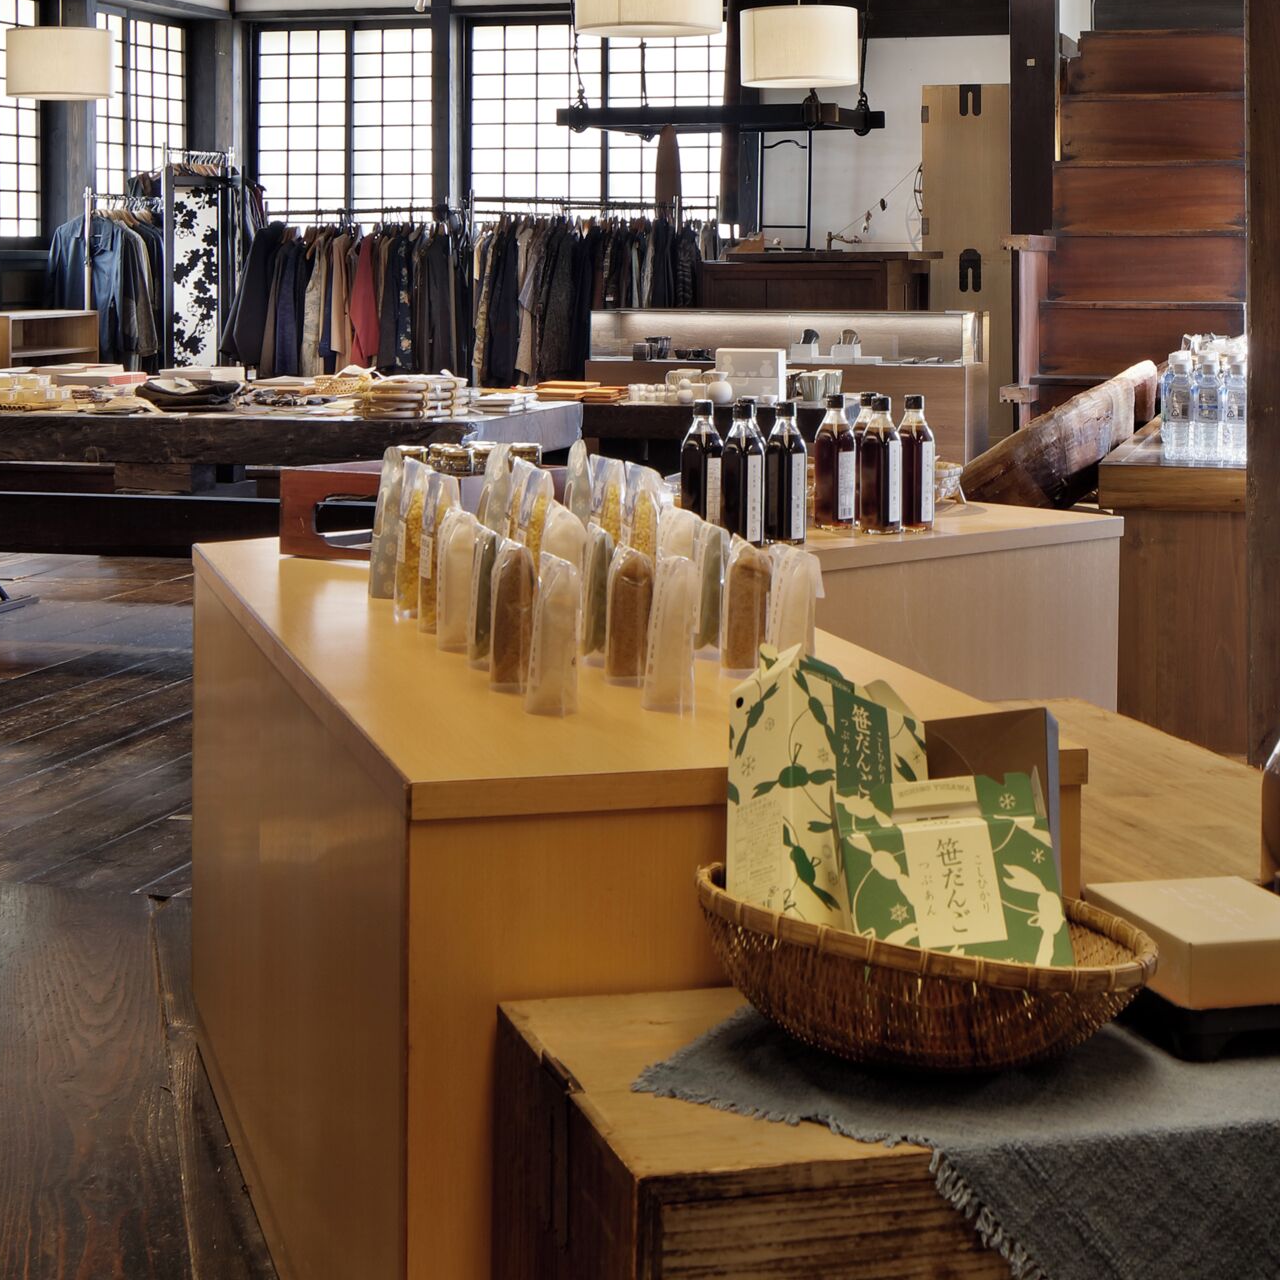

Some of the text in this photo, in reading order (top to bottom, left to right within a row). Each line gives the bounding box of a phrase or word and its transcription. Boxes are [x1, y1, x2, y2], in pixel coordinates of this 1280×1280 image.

[840, 718, 851, 768] つぶあん
[851, 704, 872, 795] 笹だんご
[876, 731, 886, 784] こしひかり
[919, 862, 936, 916] つぶあん
[936, 838, 971, 933] 笹だんご
[975, 855, 991, 914] こしひかり
